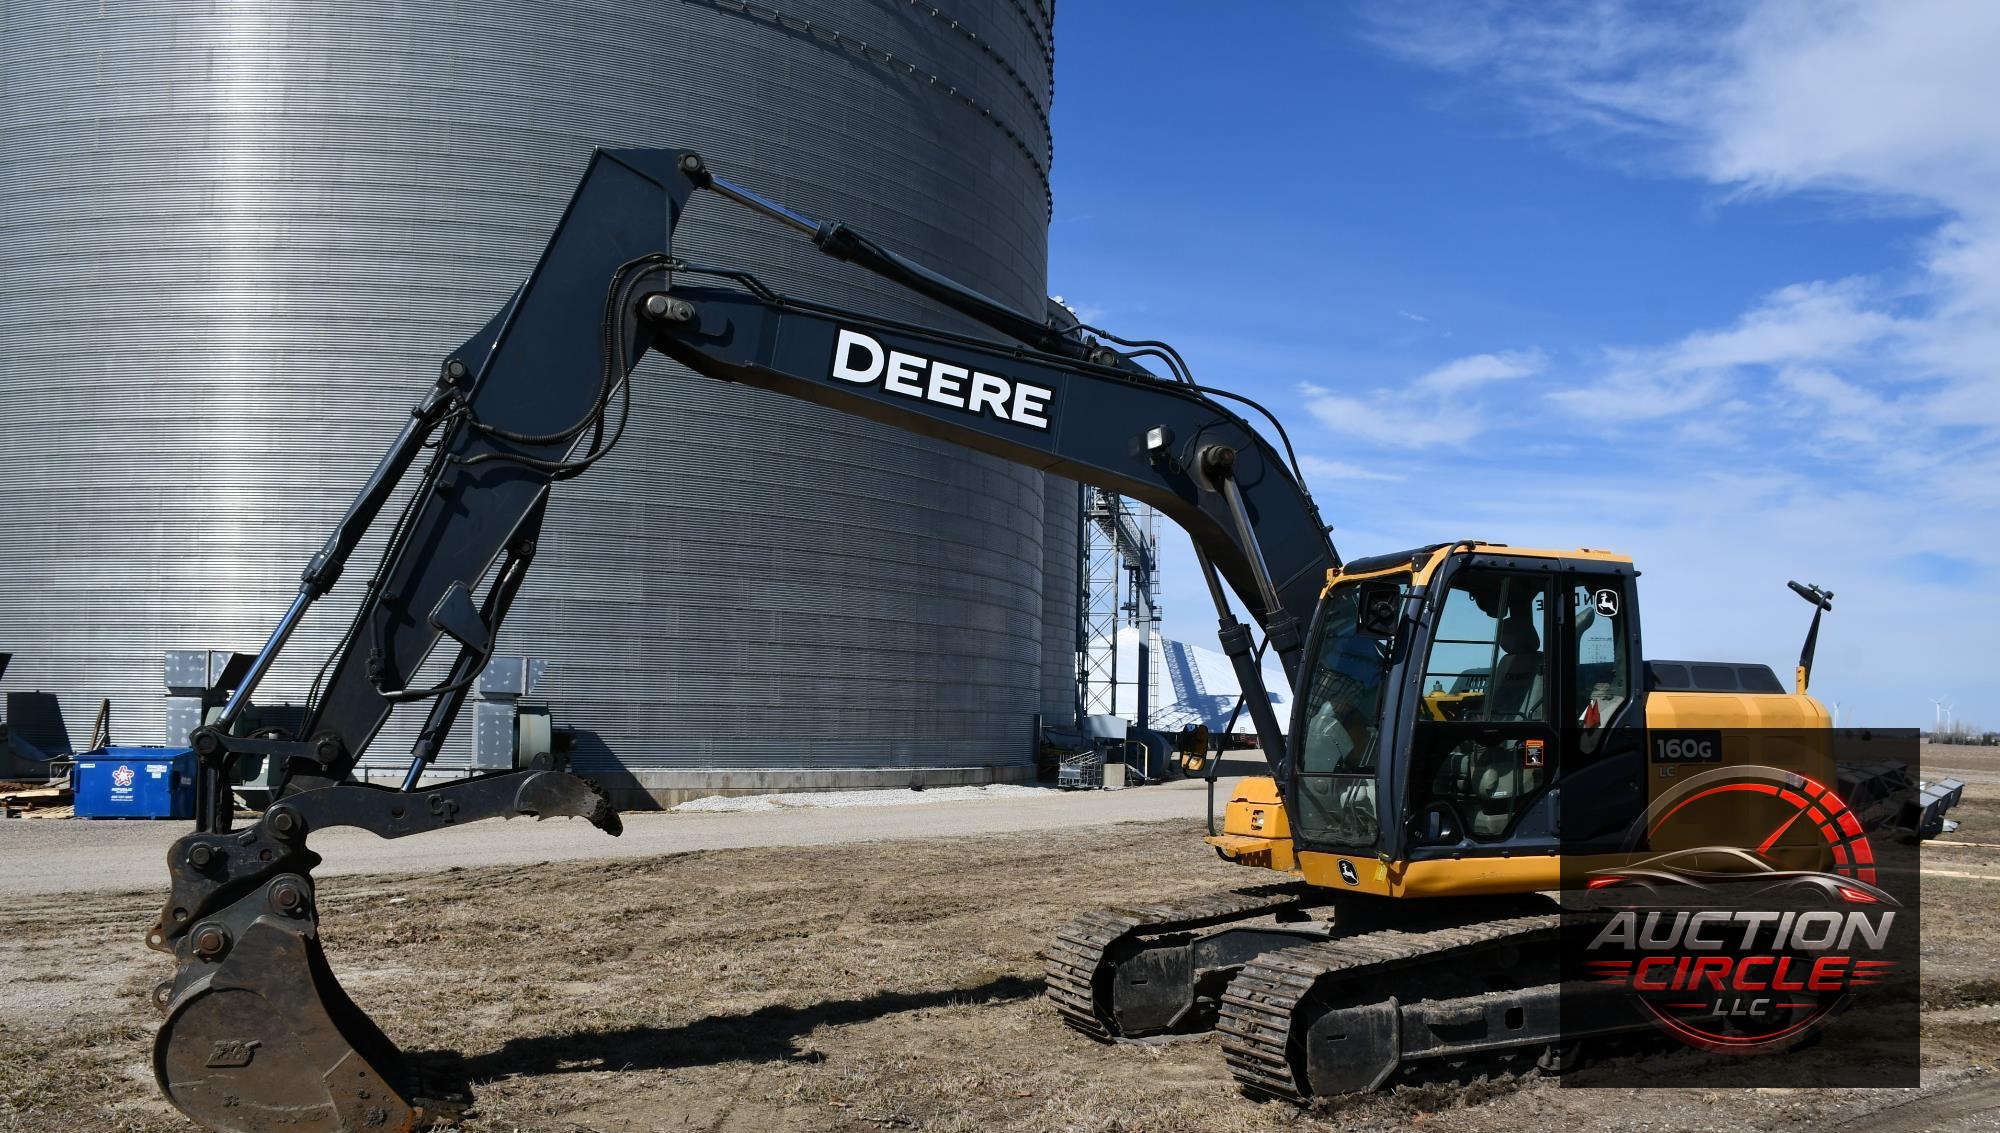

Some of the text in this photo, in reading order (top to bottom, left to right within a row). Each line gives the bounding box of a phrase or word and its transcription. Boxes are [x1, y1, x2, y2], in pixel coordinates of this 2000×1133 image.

[833, 328, 1052, 429] DEERE
[1657, 738, 1712, 759] 160G
[1659, 766, 1675, 778] LC
